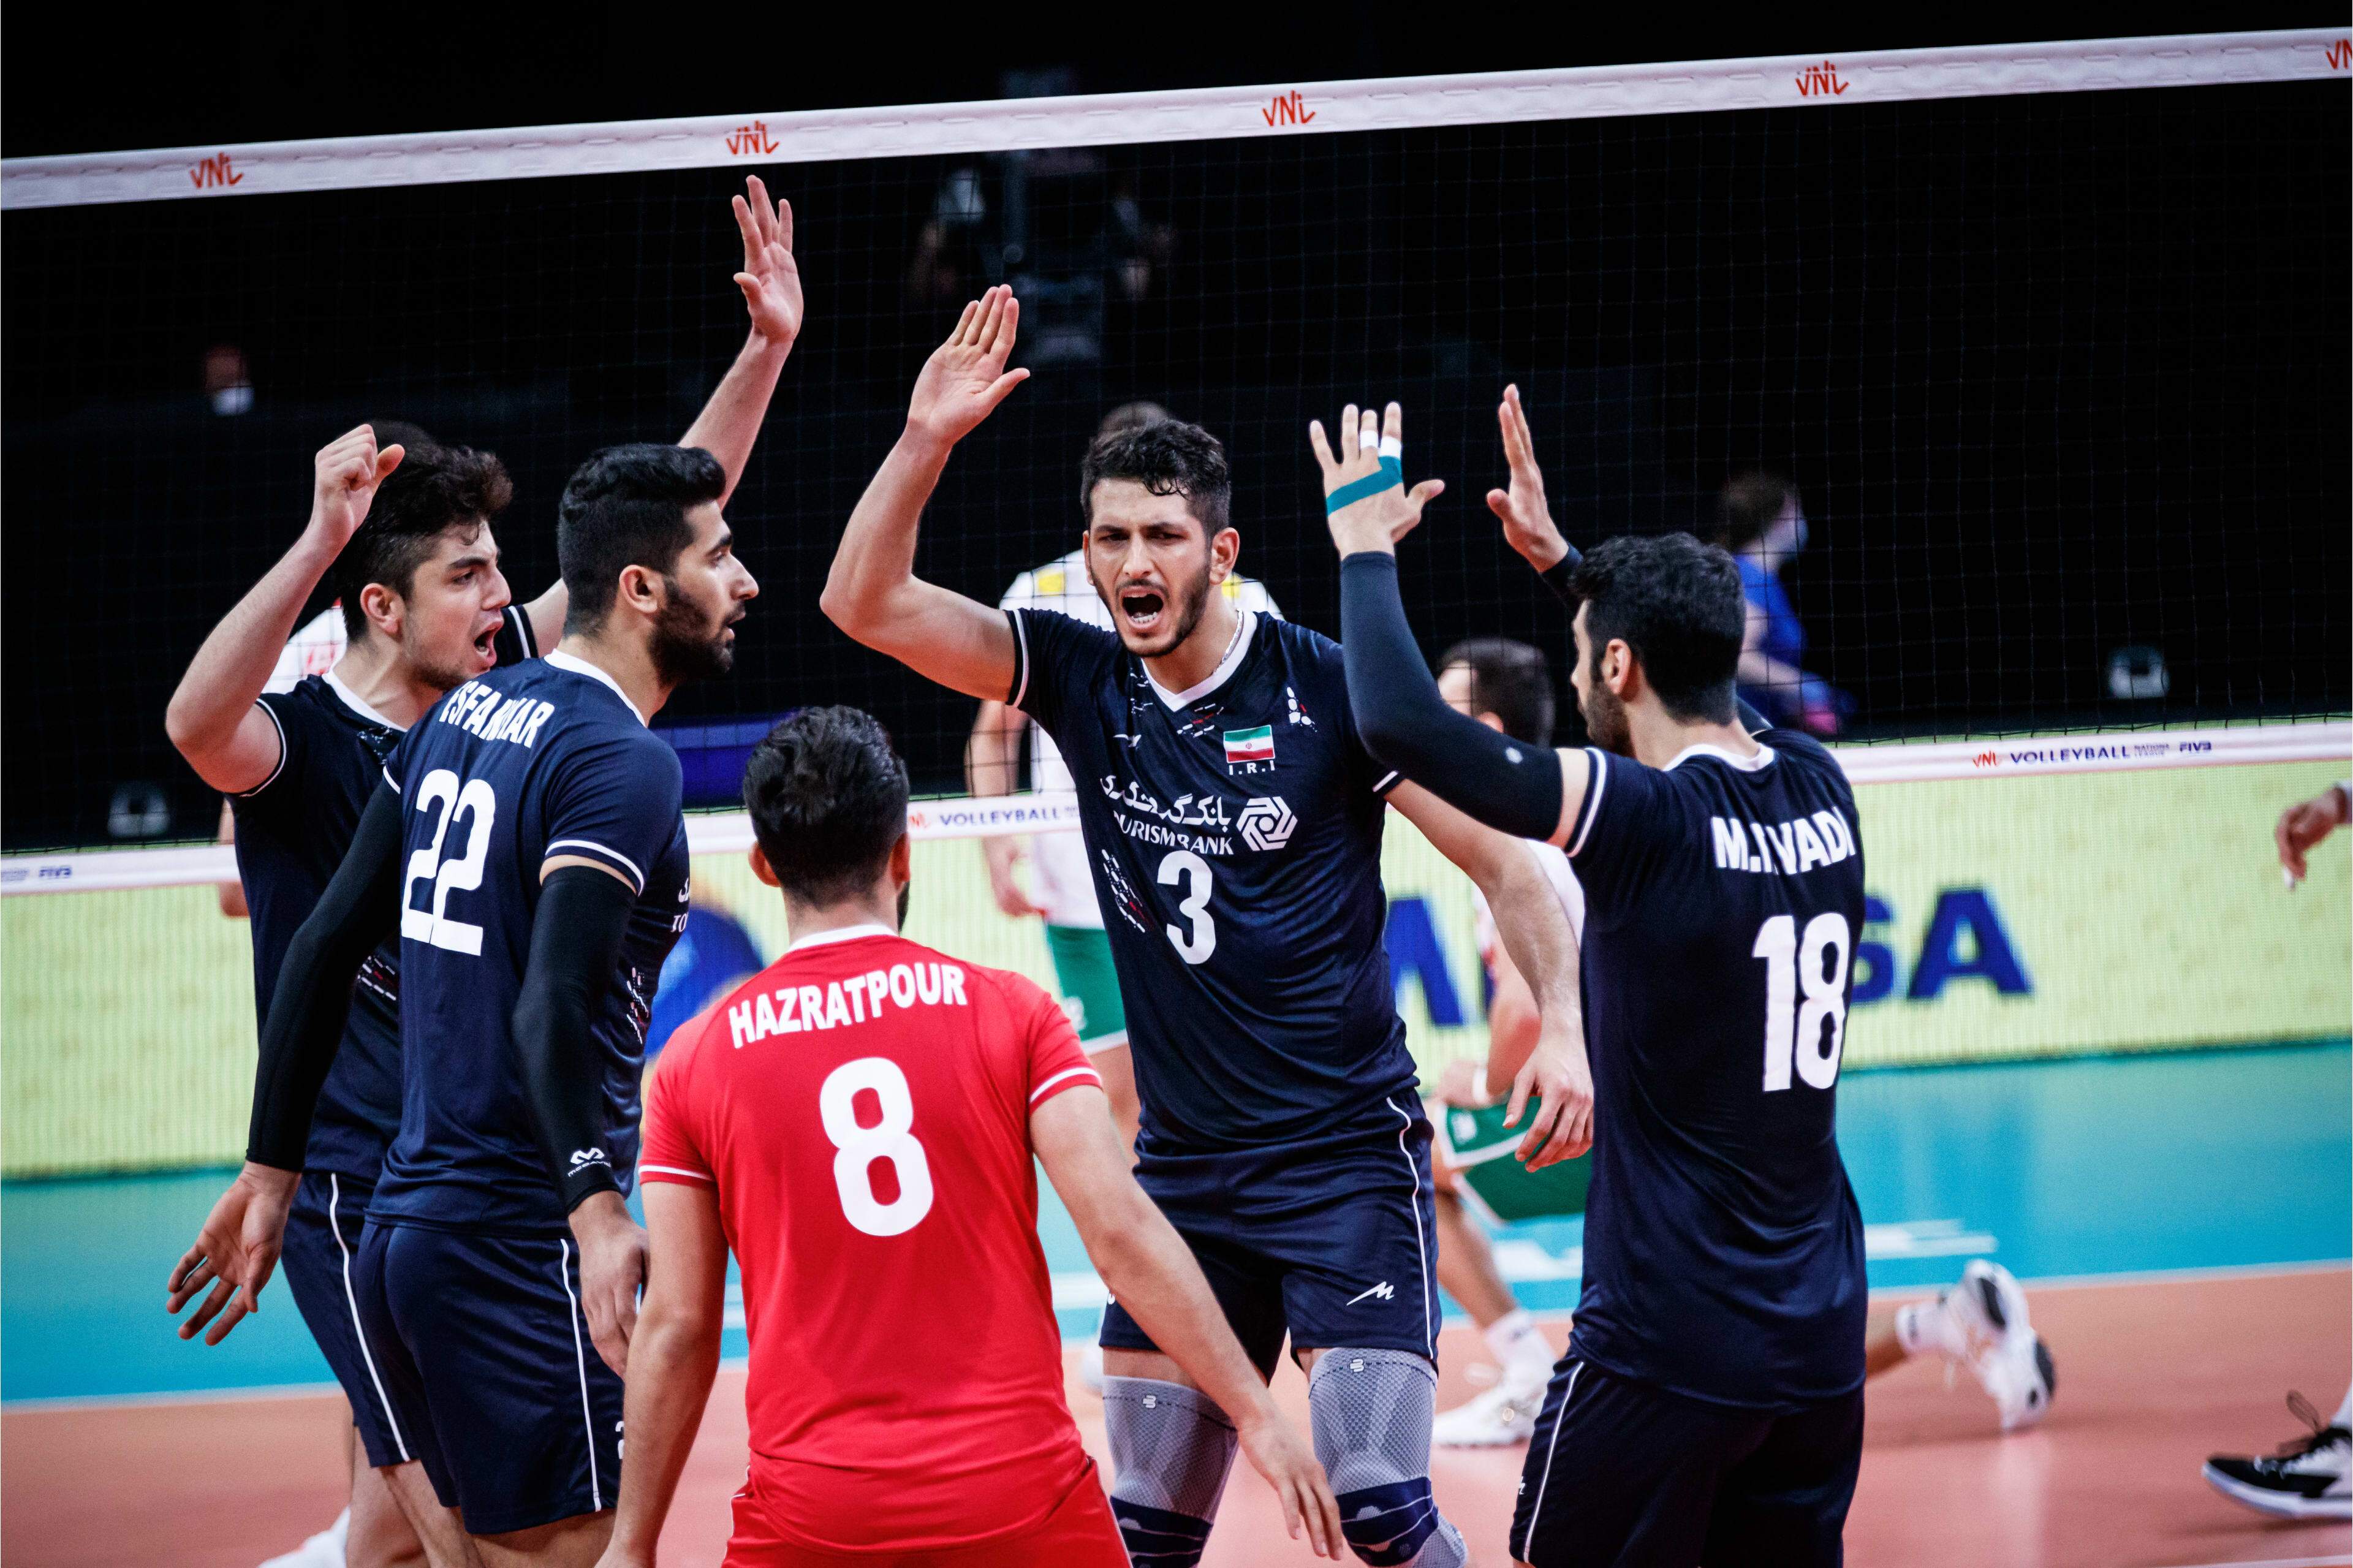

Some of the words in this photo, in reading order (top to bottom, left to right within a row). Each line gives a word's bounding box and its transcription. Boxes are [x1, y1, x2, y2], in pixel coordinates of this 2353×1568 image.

[1795, 60, 1849, 96] VNL
[1262, 90, 1316, 126] VNL
[726, 120, 779, 154] VNL
[190, 151, 243, 189] VNL
[2010, 745, 2131, 763] VOLLEYBALL
[939, 808, 1060, 826] VOLLEYBALL
[401, 769, 495, 956] 22
[1158, 850, 1216, 964] 3
[729, 962, 967, 1049] HAZRATPOUR
[1752, 912, 1850, 1092] 18
[820, 1057, 934, 1237] 8
